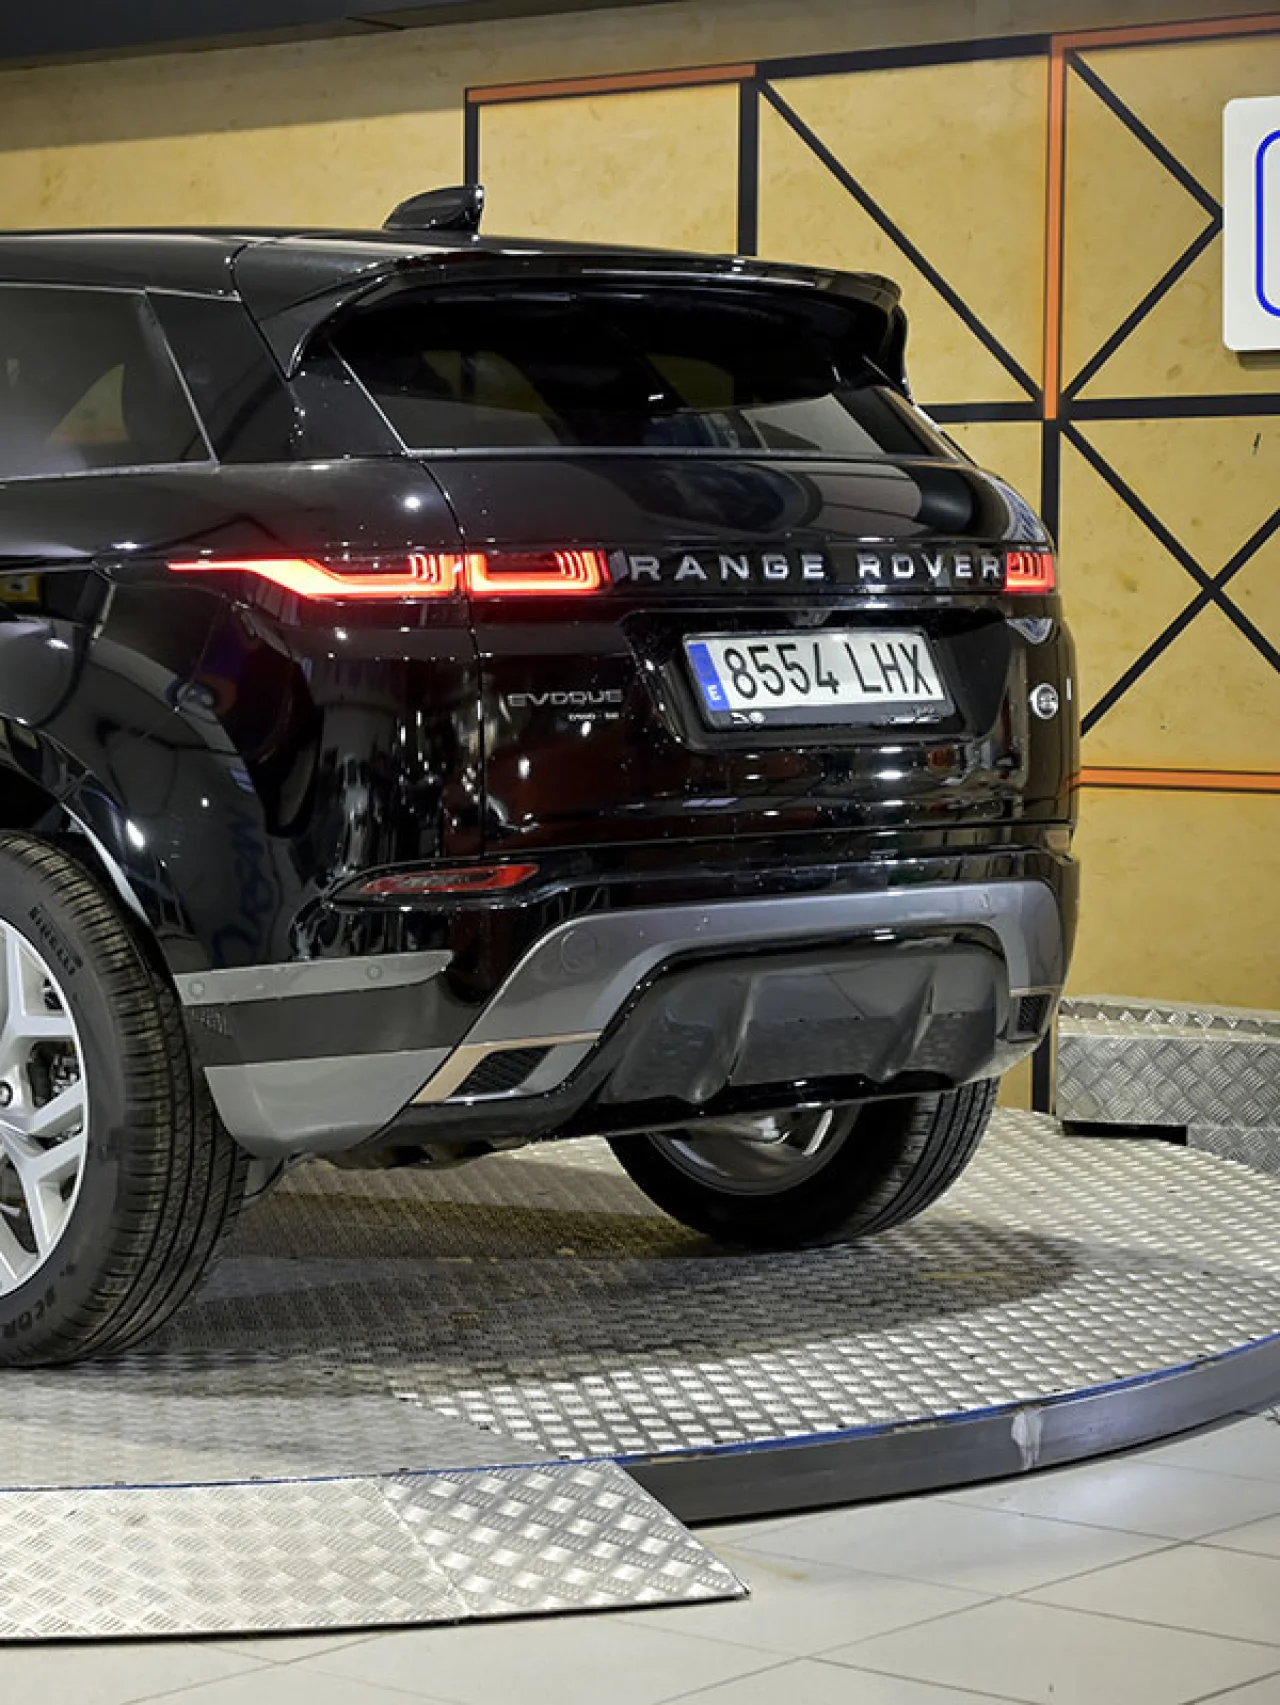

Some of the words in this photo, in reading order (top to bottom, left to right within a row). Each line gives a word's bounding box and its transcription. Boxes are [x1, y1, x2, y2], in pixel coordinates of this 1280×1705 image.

[628, 554, 825, 581] RANGE
[856, 553, 1001, 579] ROVER
[723, 641, 839, 700] 8554
[843, 641, 933, 696] LHX
[507, 689, 622, 707] EVOQUE
[706, 684, 721, 701] E
